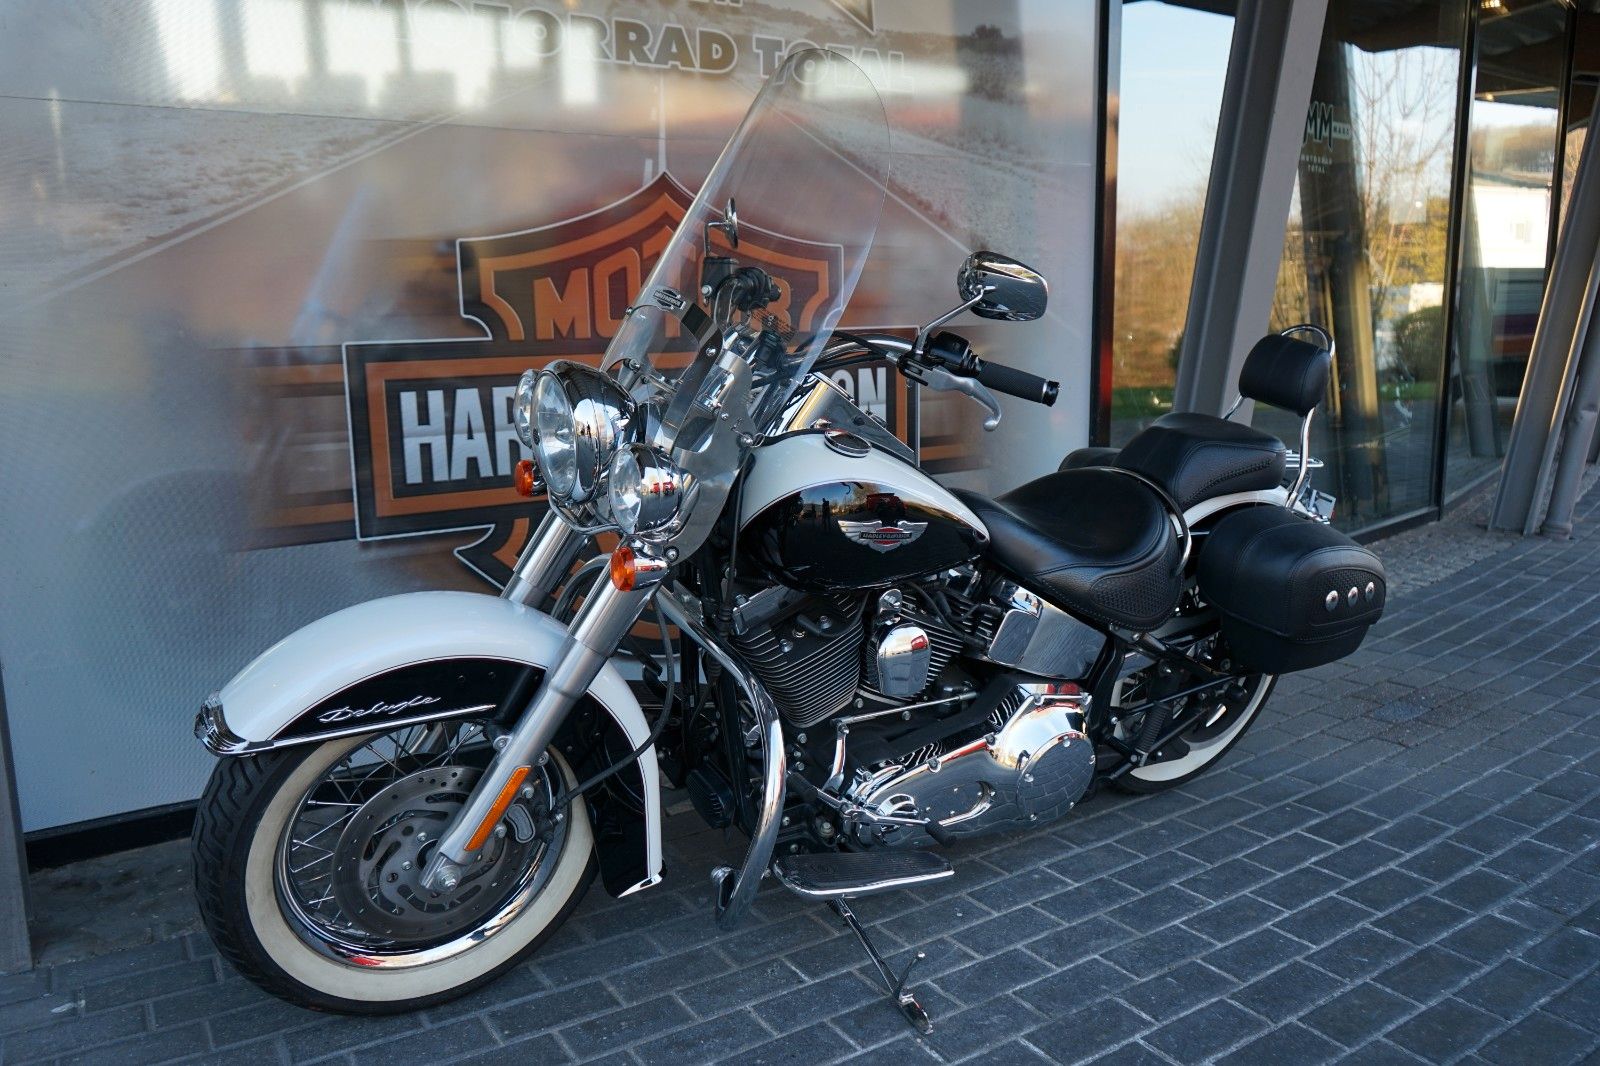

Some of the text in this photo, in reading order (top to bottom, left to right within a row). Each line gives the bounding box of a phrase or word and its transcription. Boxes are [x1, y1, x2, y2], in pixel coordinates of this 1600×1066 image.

[328, 0, 914, 94] OTORRAD TOTAL
[533, 225, 792, 340] MOTR
[318, 694, 442, 723] Deluxe
